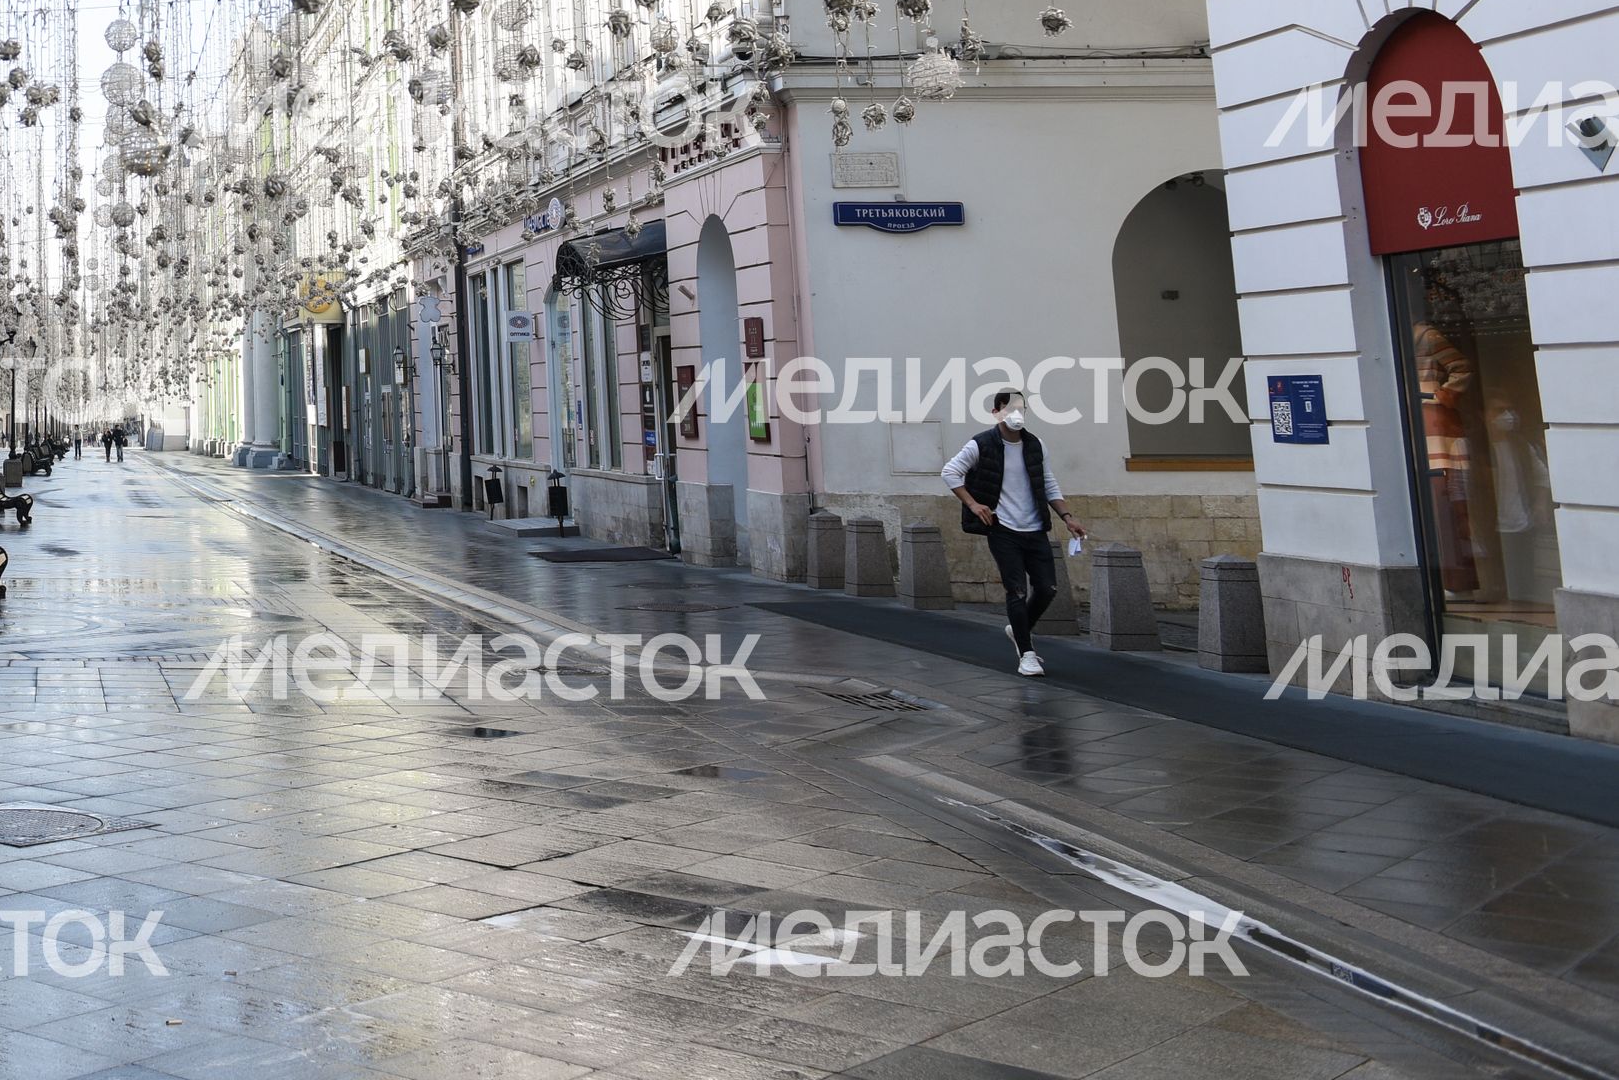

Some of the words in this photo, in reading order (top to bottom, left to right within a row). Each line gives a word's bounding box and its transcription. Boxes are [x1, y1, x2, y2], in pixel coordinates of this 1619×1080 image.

[855, 207, 946, 218] ТРЕТЬЯКОВСКИЙ
[1432, 206, 1455, 227] Loro
[1455, 202, 1482, 224] Piana
